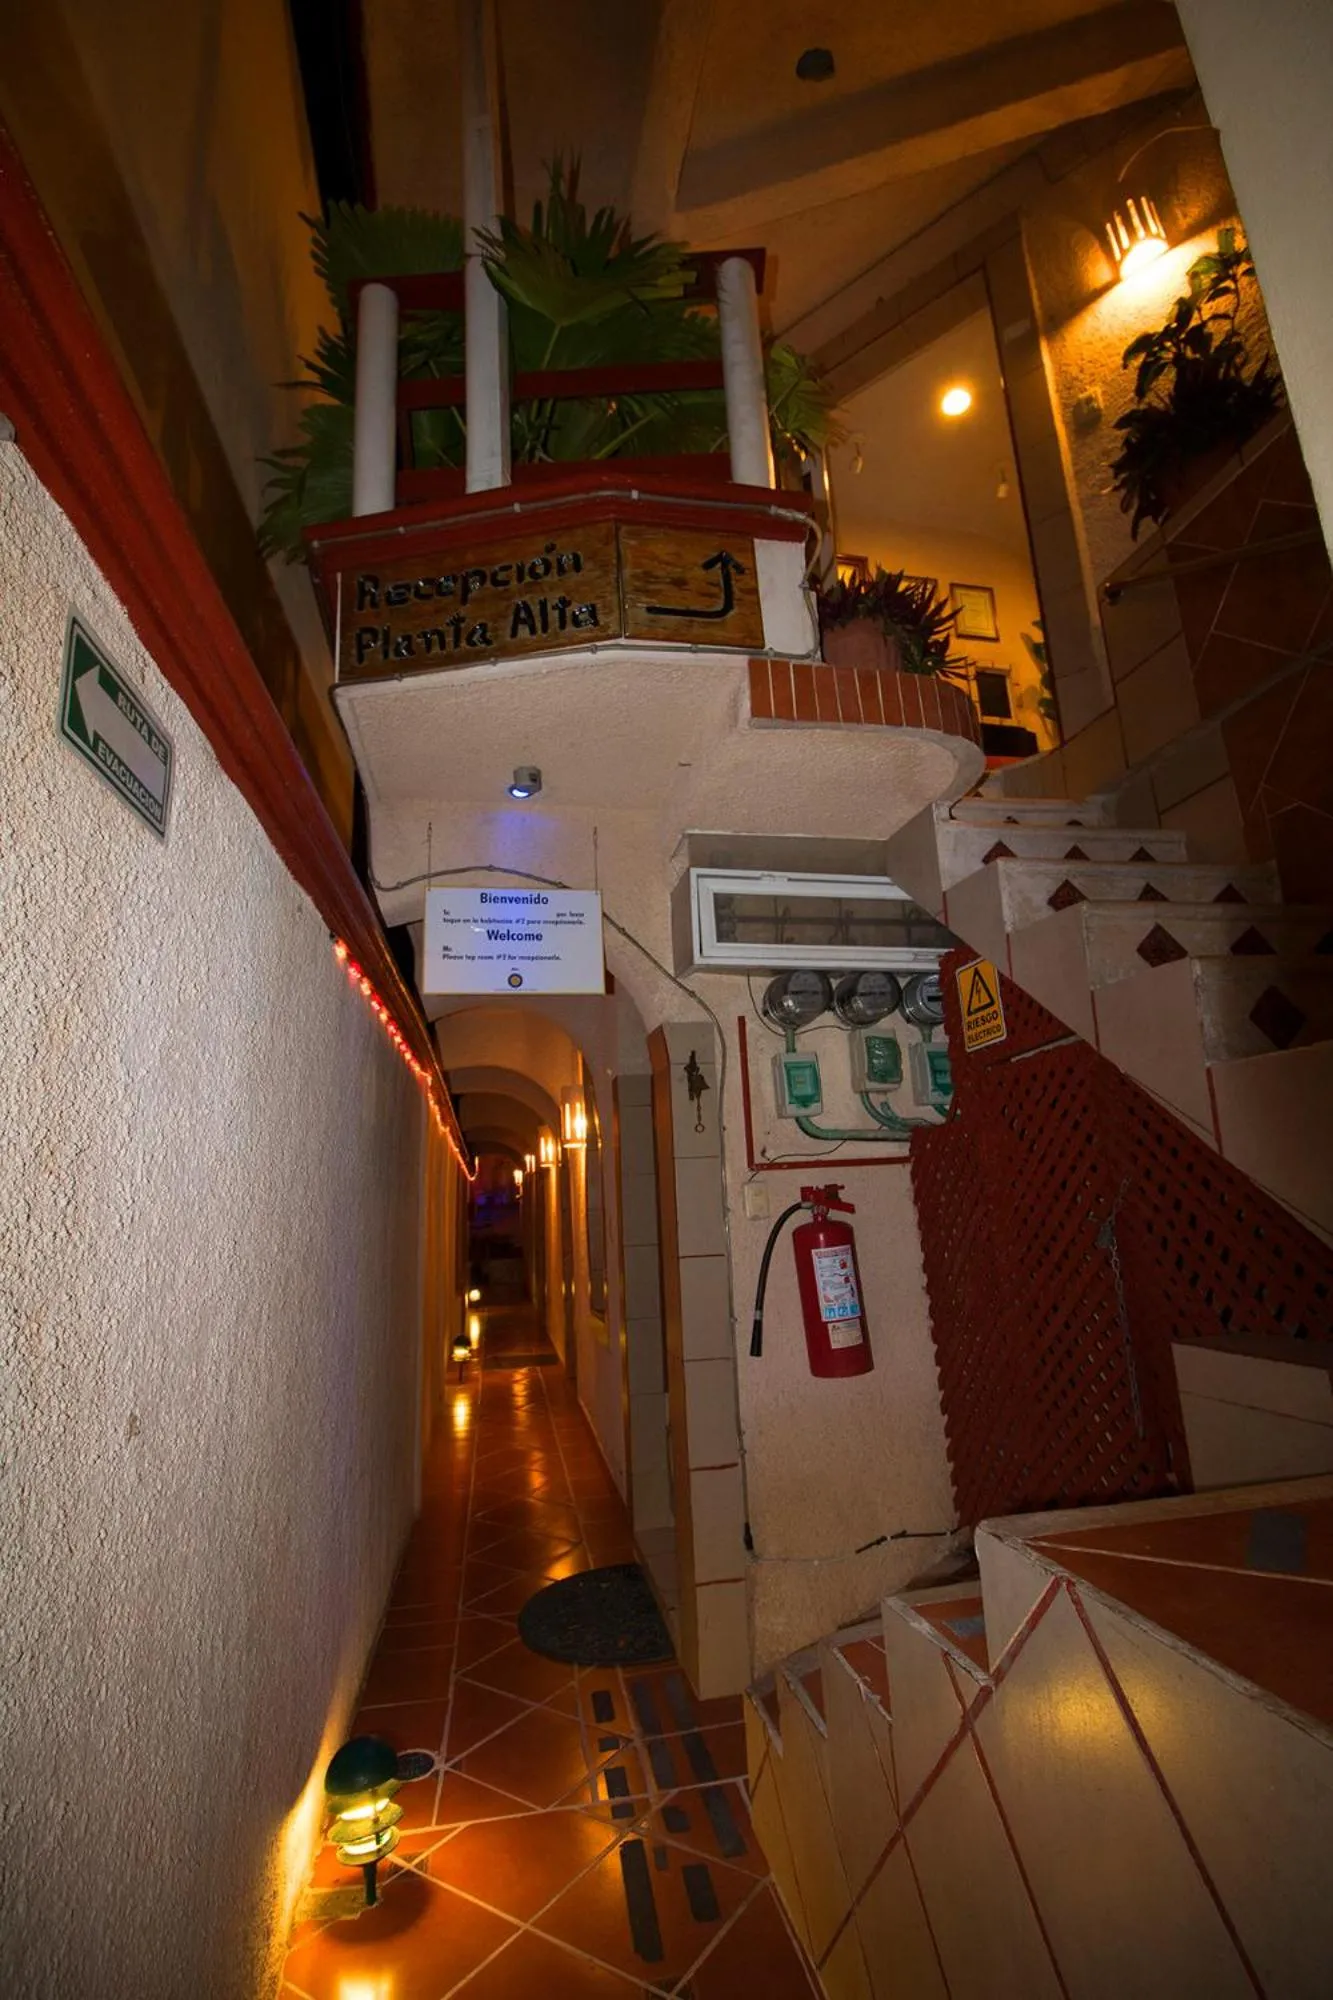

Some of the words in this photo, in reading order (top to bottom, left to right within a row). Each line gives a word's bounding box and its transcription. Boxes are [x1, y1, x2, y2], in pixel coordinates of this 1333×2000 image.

[355, 612, 493, 665] Planta
[509, 596, 601, 639] Alta
[118, 690, 151, 743] RUTA
[152, 736, 167, 764] DE
[479, 892, 549, 905] Bienvenido
[486, 929, 543, 941] Welcome
[967, 1009, 999, 1032] RIESGO
